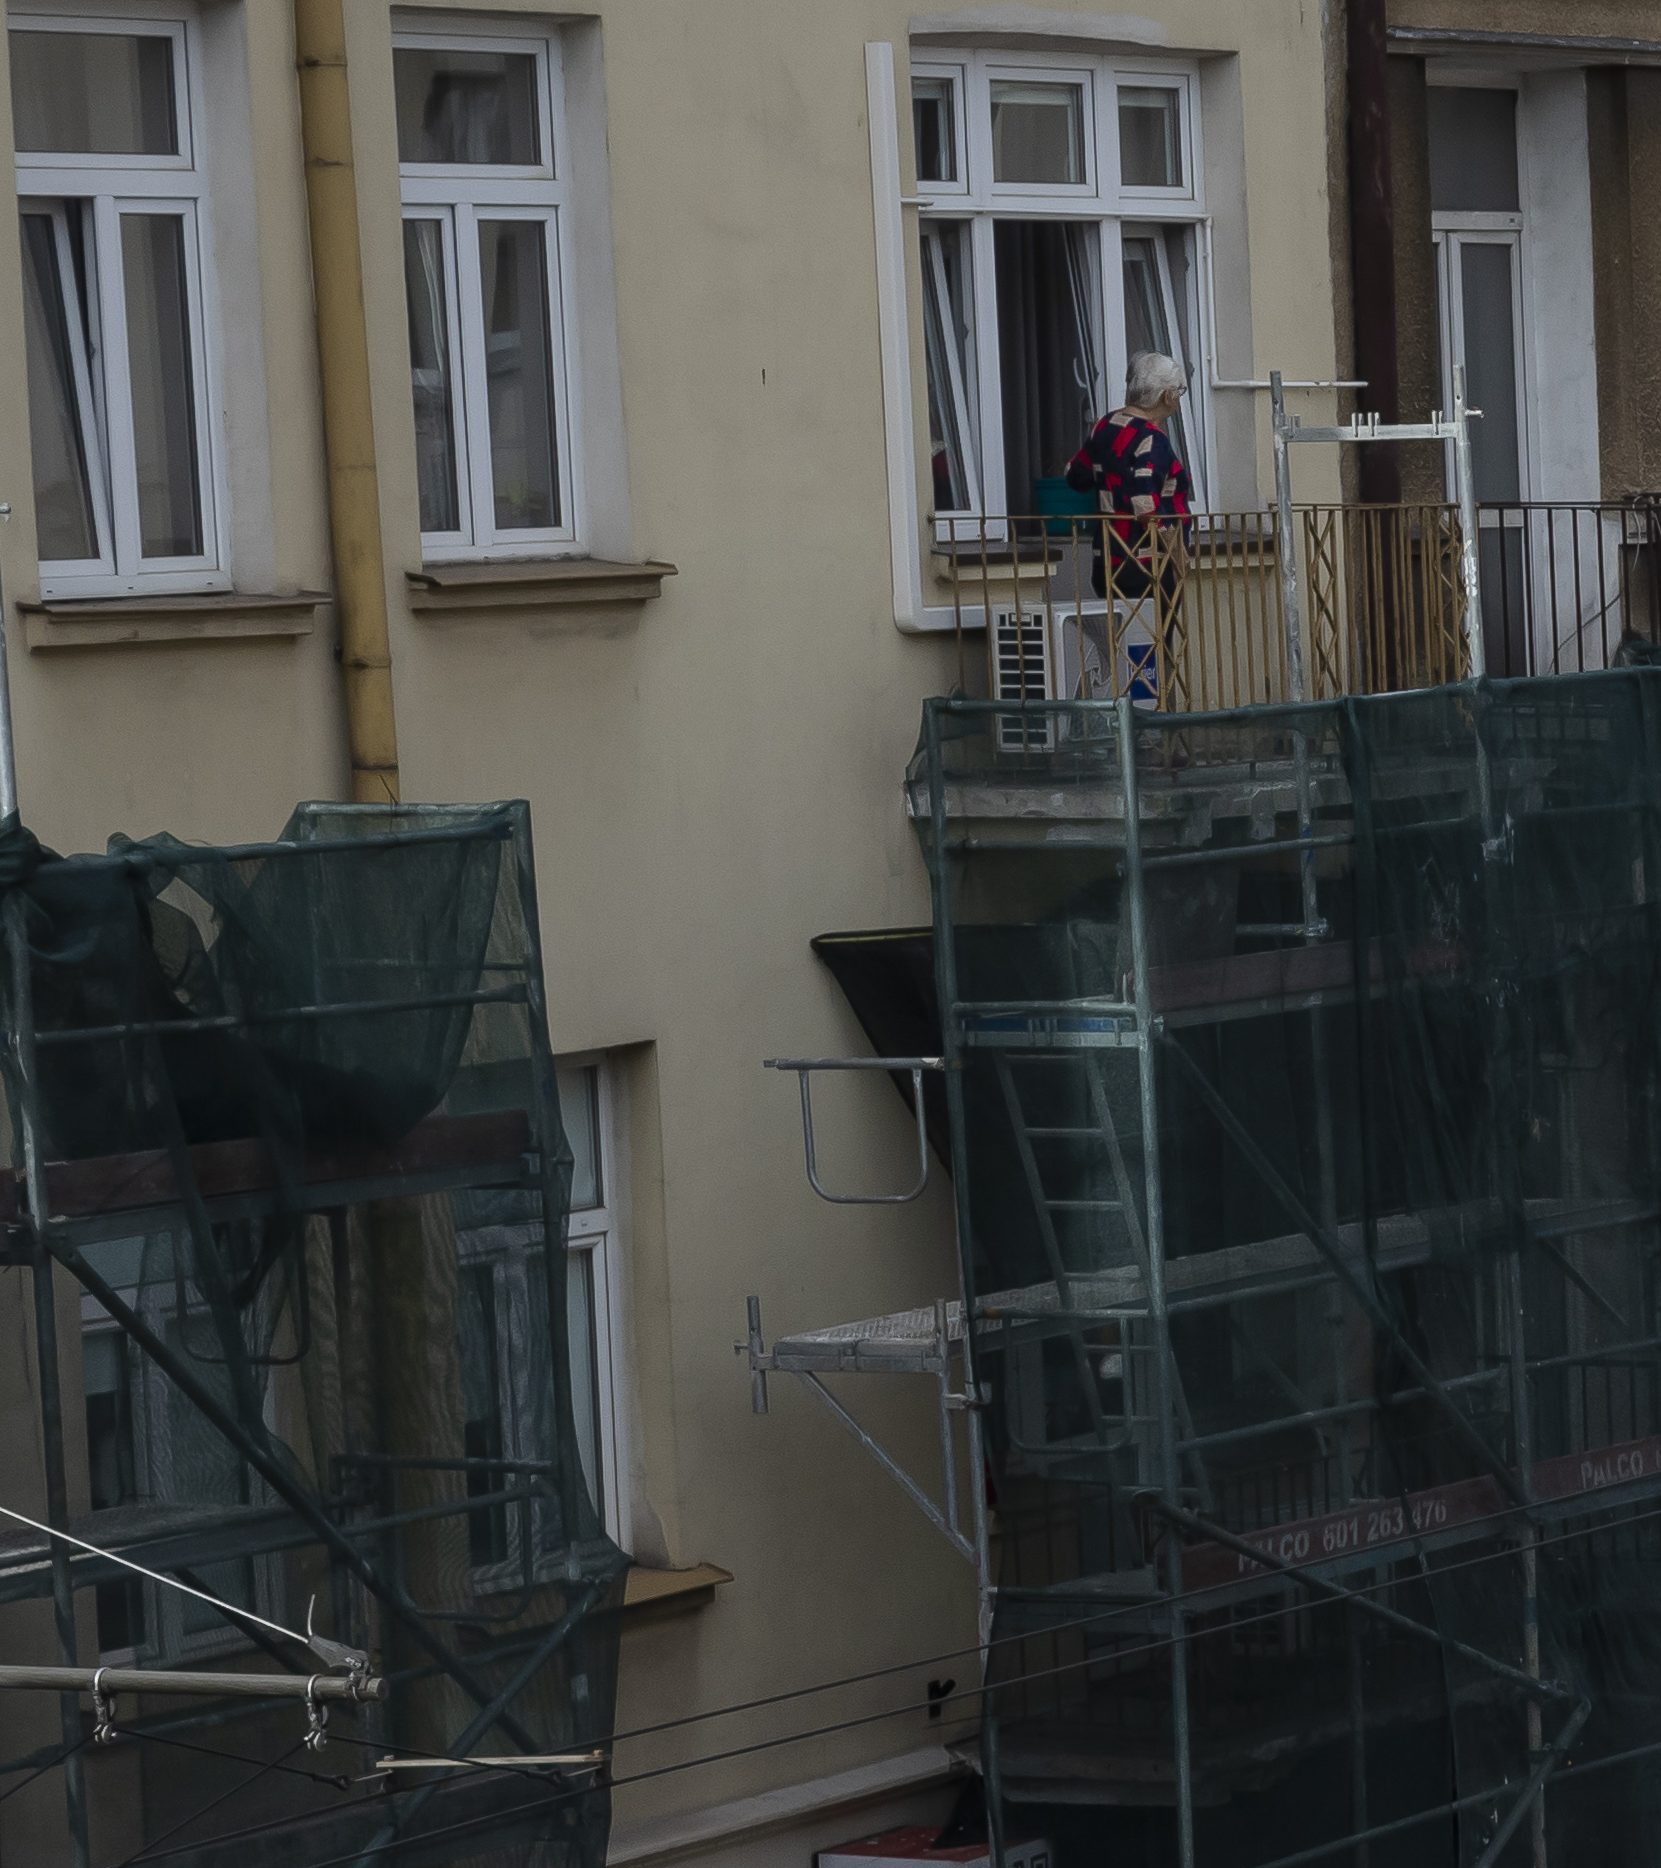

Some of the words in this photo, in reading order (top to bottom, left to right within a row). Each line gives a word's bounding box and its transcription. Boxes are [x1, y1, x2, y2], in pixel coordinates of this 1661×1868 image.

[1580, 1450, 1645, 1489] PALCO
[1322, 1514, 1360, 1554] 601
[1365, 1507, 1406, 1544] 263
[1410, 1497, 1449, 1535] 476
